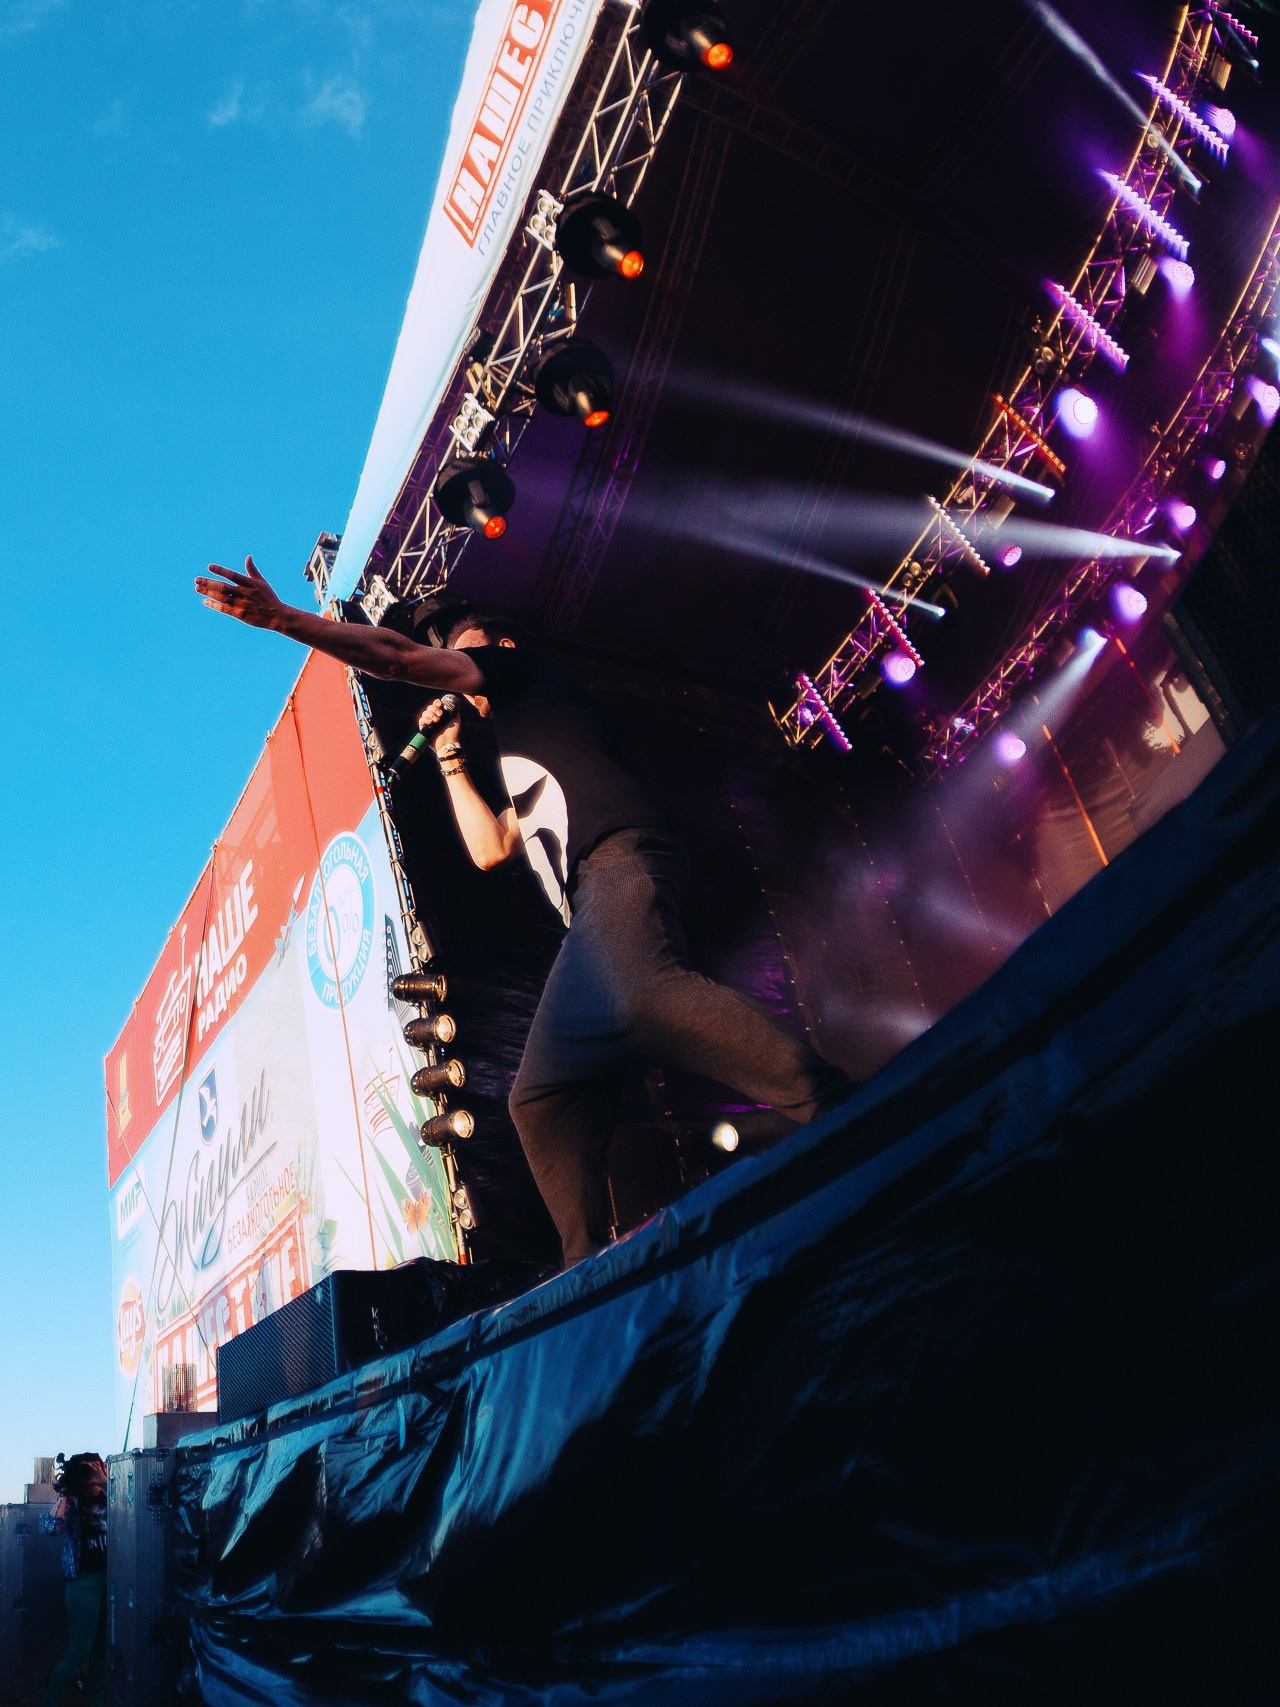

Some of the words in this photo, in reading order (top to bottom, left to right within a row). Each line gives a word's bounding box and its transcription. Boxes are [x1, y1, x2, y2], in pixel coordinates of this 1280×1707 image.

[450, 0, 553, 236] НАШЕС
[477, 135, 532, 257] ГЛАВНОЕ
[194, 858, 259, 1009] НАШЕ
[322, 929, 372, 1003] ПРОДУКЦИЯ
[197, 953, 248, 1043] РАДИО
[227, 1161, 296, 1254] БЕЗАЛКОГОЛЬНОЕ
